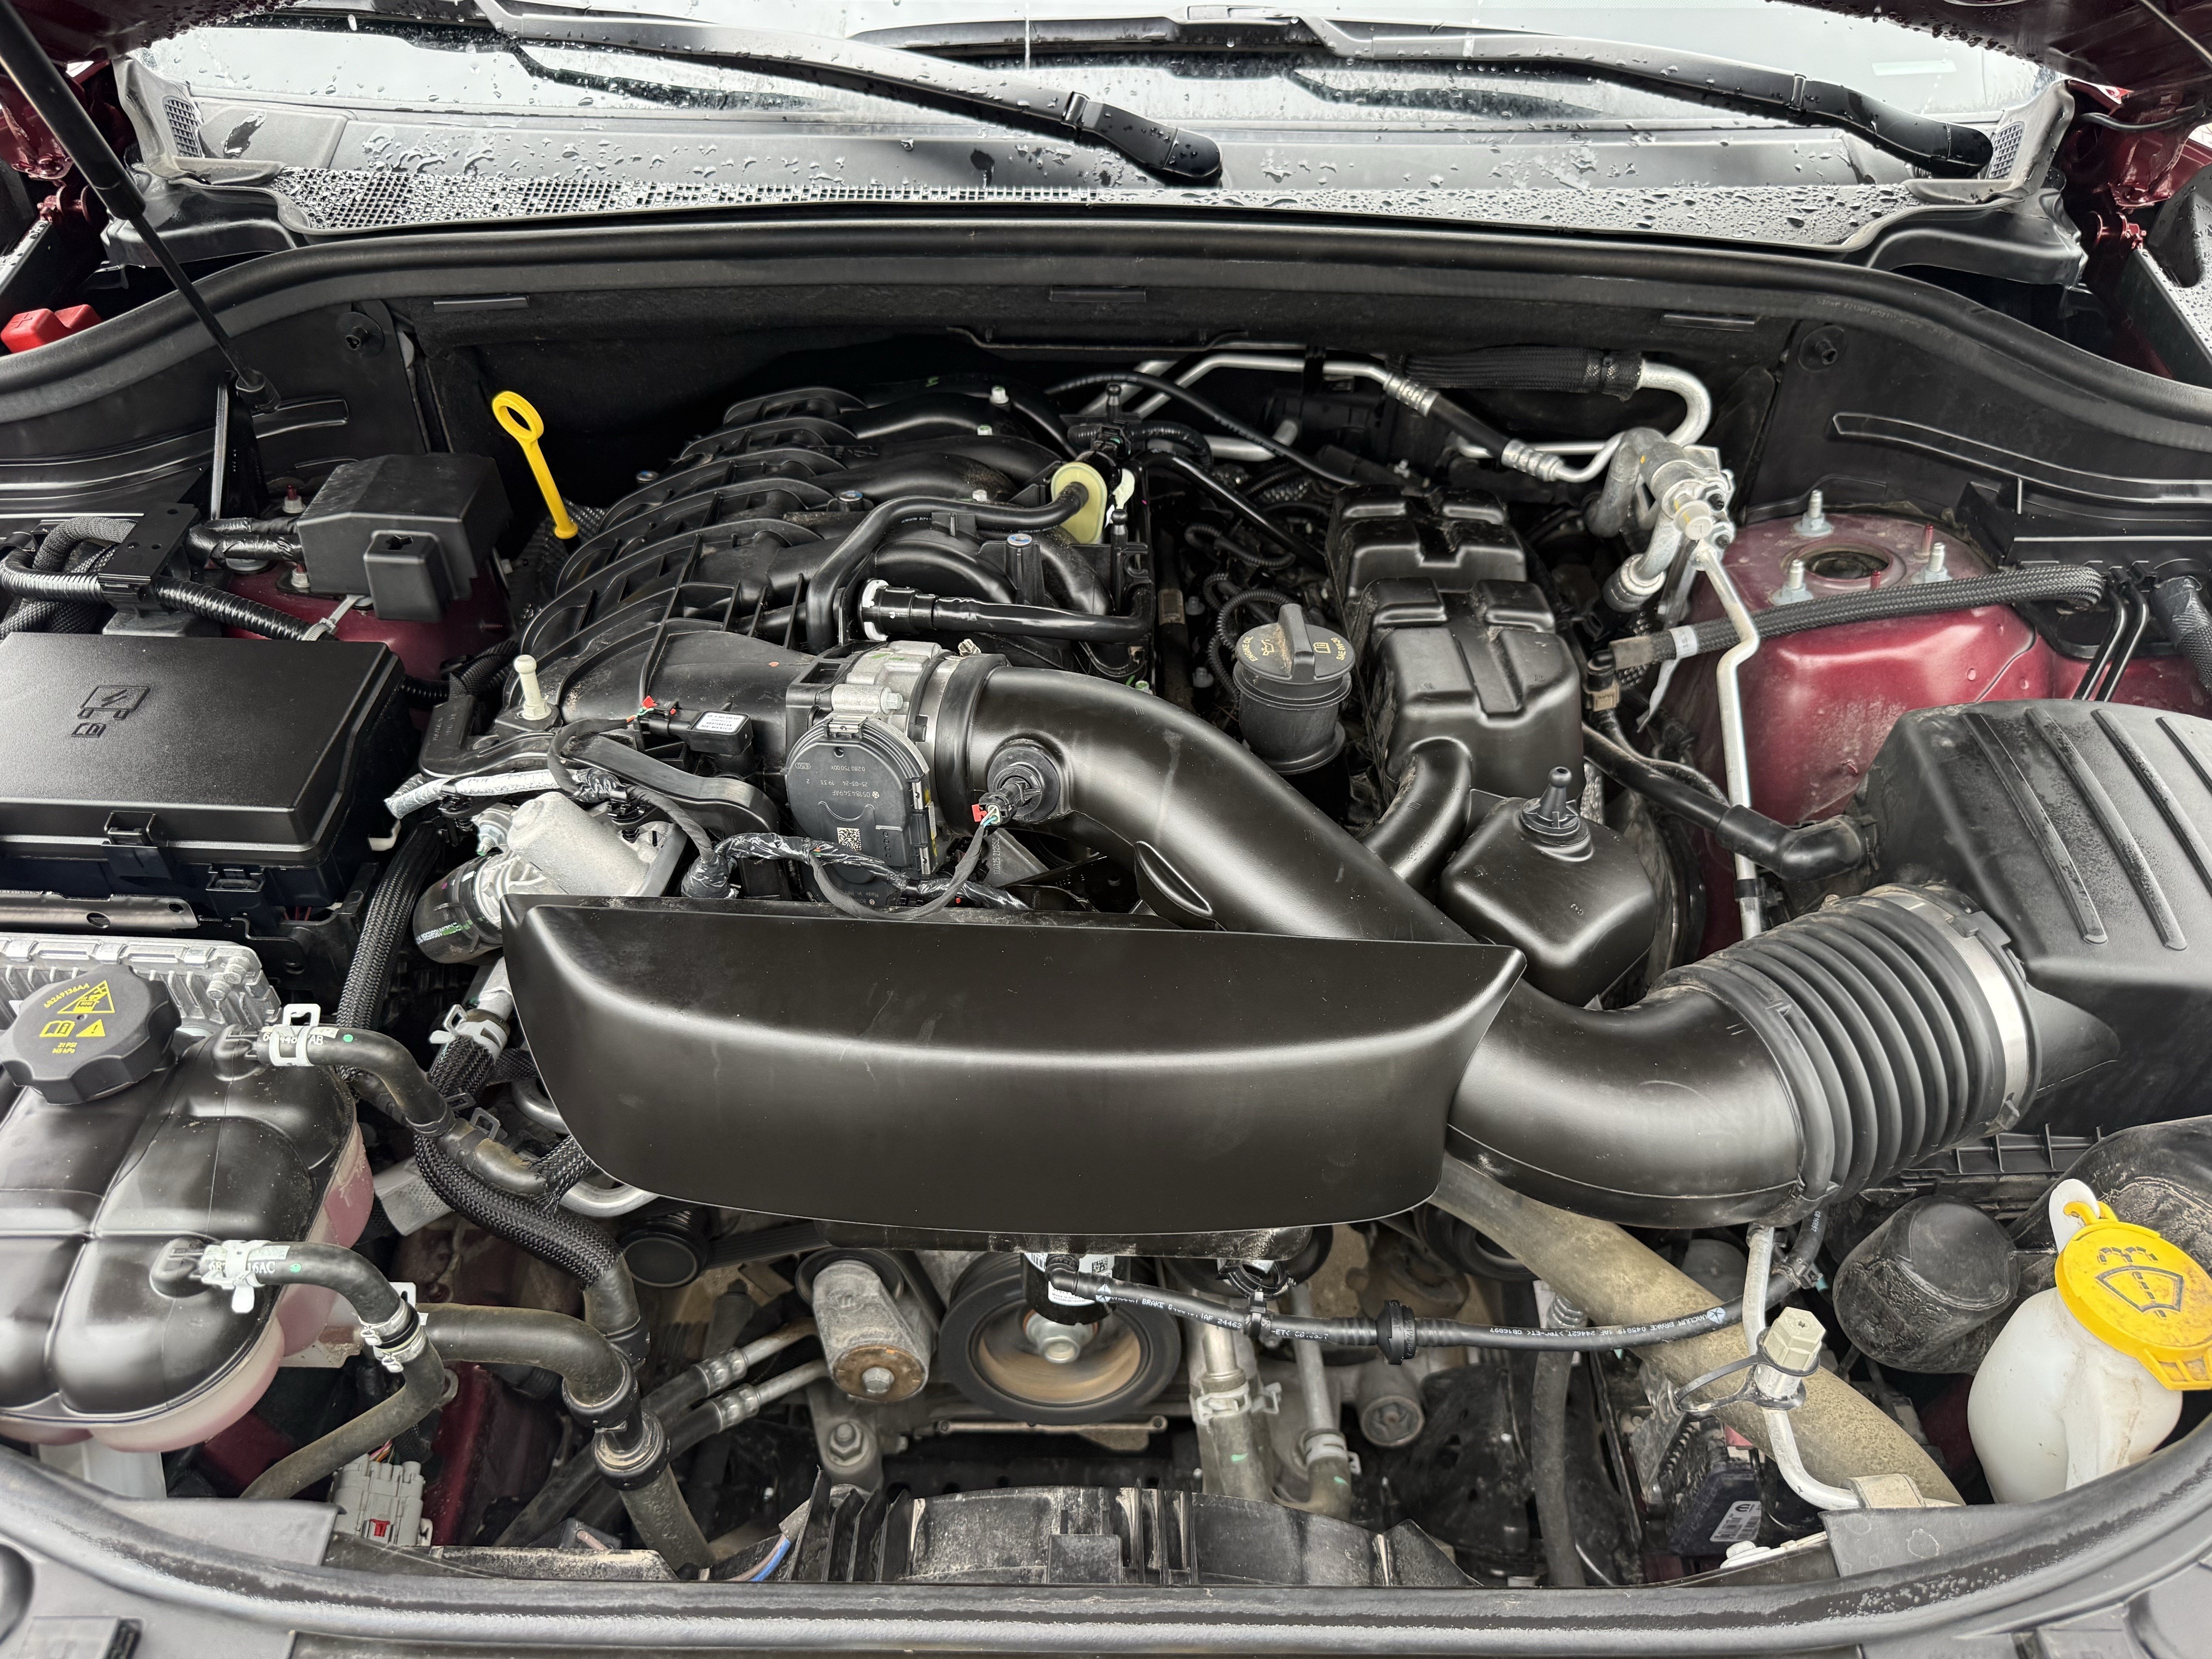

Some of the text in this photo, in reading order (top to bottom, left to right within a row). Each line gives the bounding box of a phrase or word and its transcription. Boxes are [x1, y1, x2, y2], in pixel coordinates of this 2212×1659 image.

[1242, 644, 1258, 661] ENGINE
[1336, 651, 1346, 660] SAE
[263, 1032, 324, 1046] 6440AB
[208, 1261, 276, 1274] 6816AC
[1142, 1298, 1164, 1309] BRAKE
[1650, 1321, 1674, 1330] BRAKE
[1678, 1314, 1708, 1326] VACUUM
